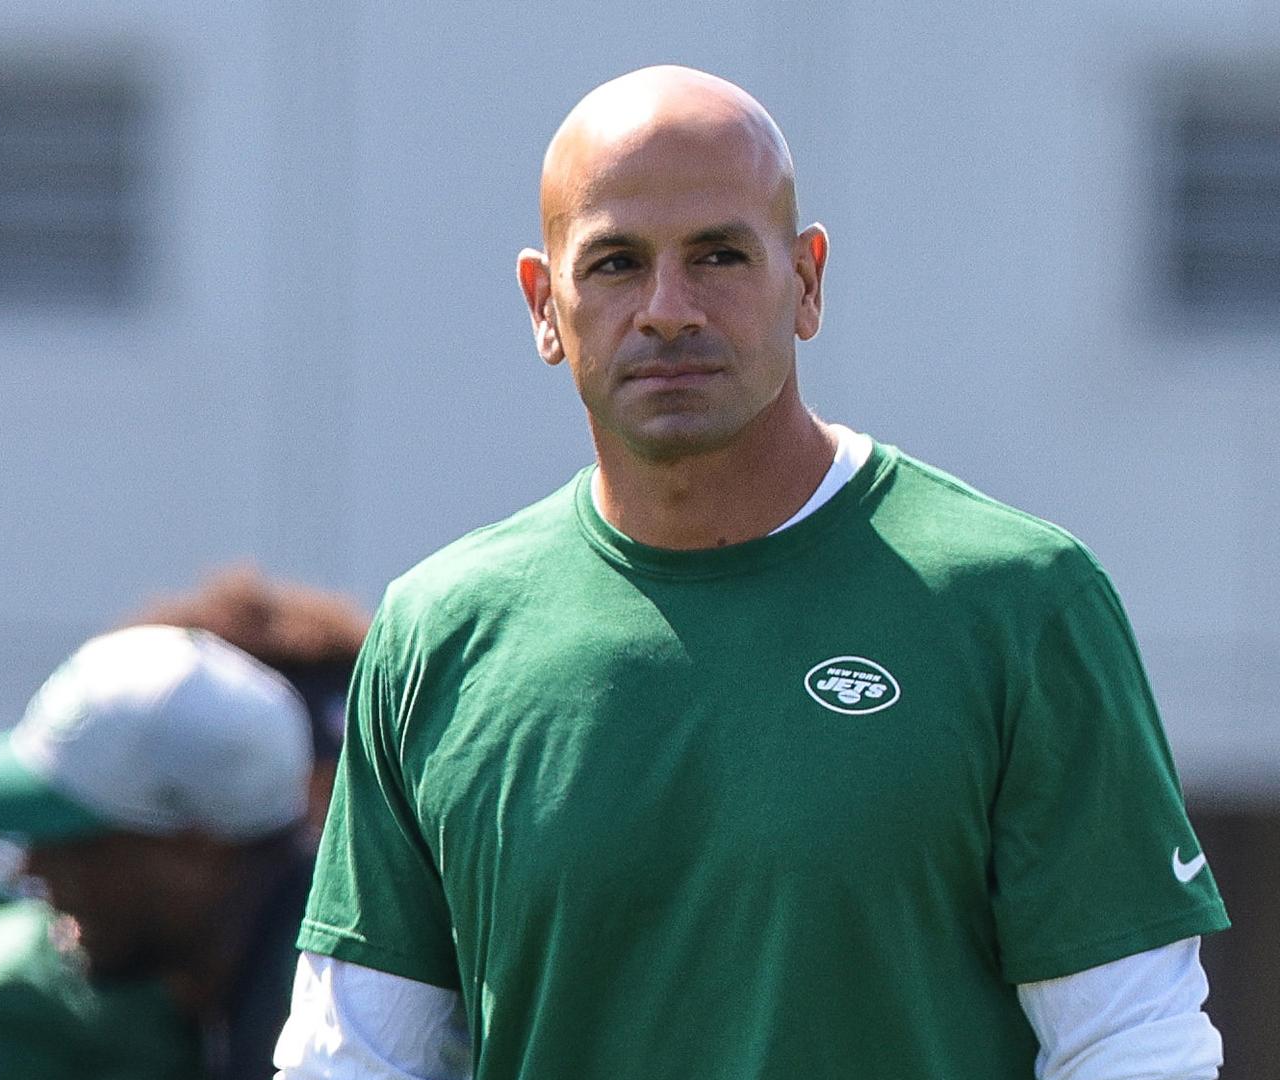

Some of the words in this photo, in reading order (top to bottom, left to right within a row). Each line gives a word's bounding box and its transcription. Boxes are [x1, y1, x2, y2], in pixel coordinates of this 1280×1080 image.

[827, 668, 852, 677] NEW
[852, 671, 881, 682] YORK
[817, 677, 887, 698] JETS
